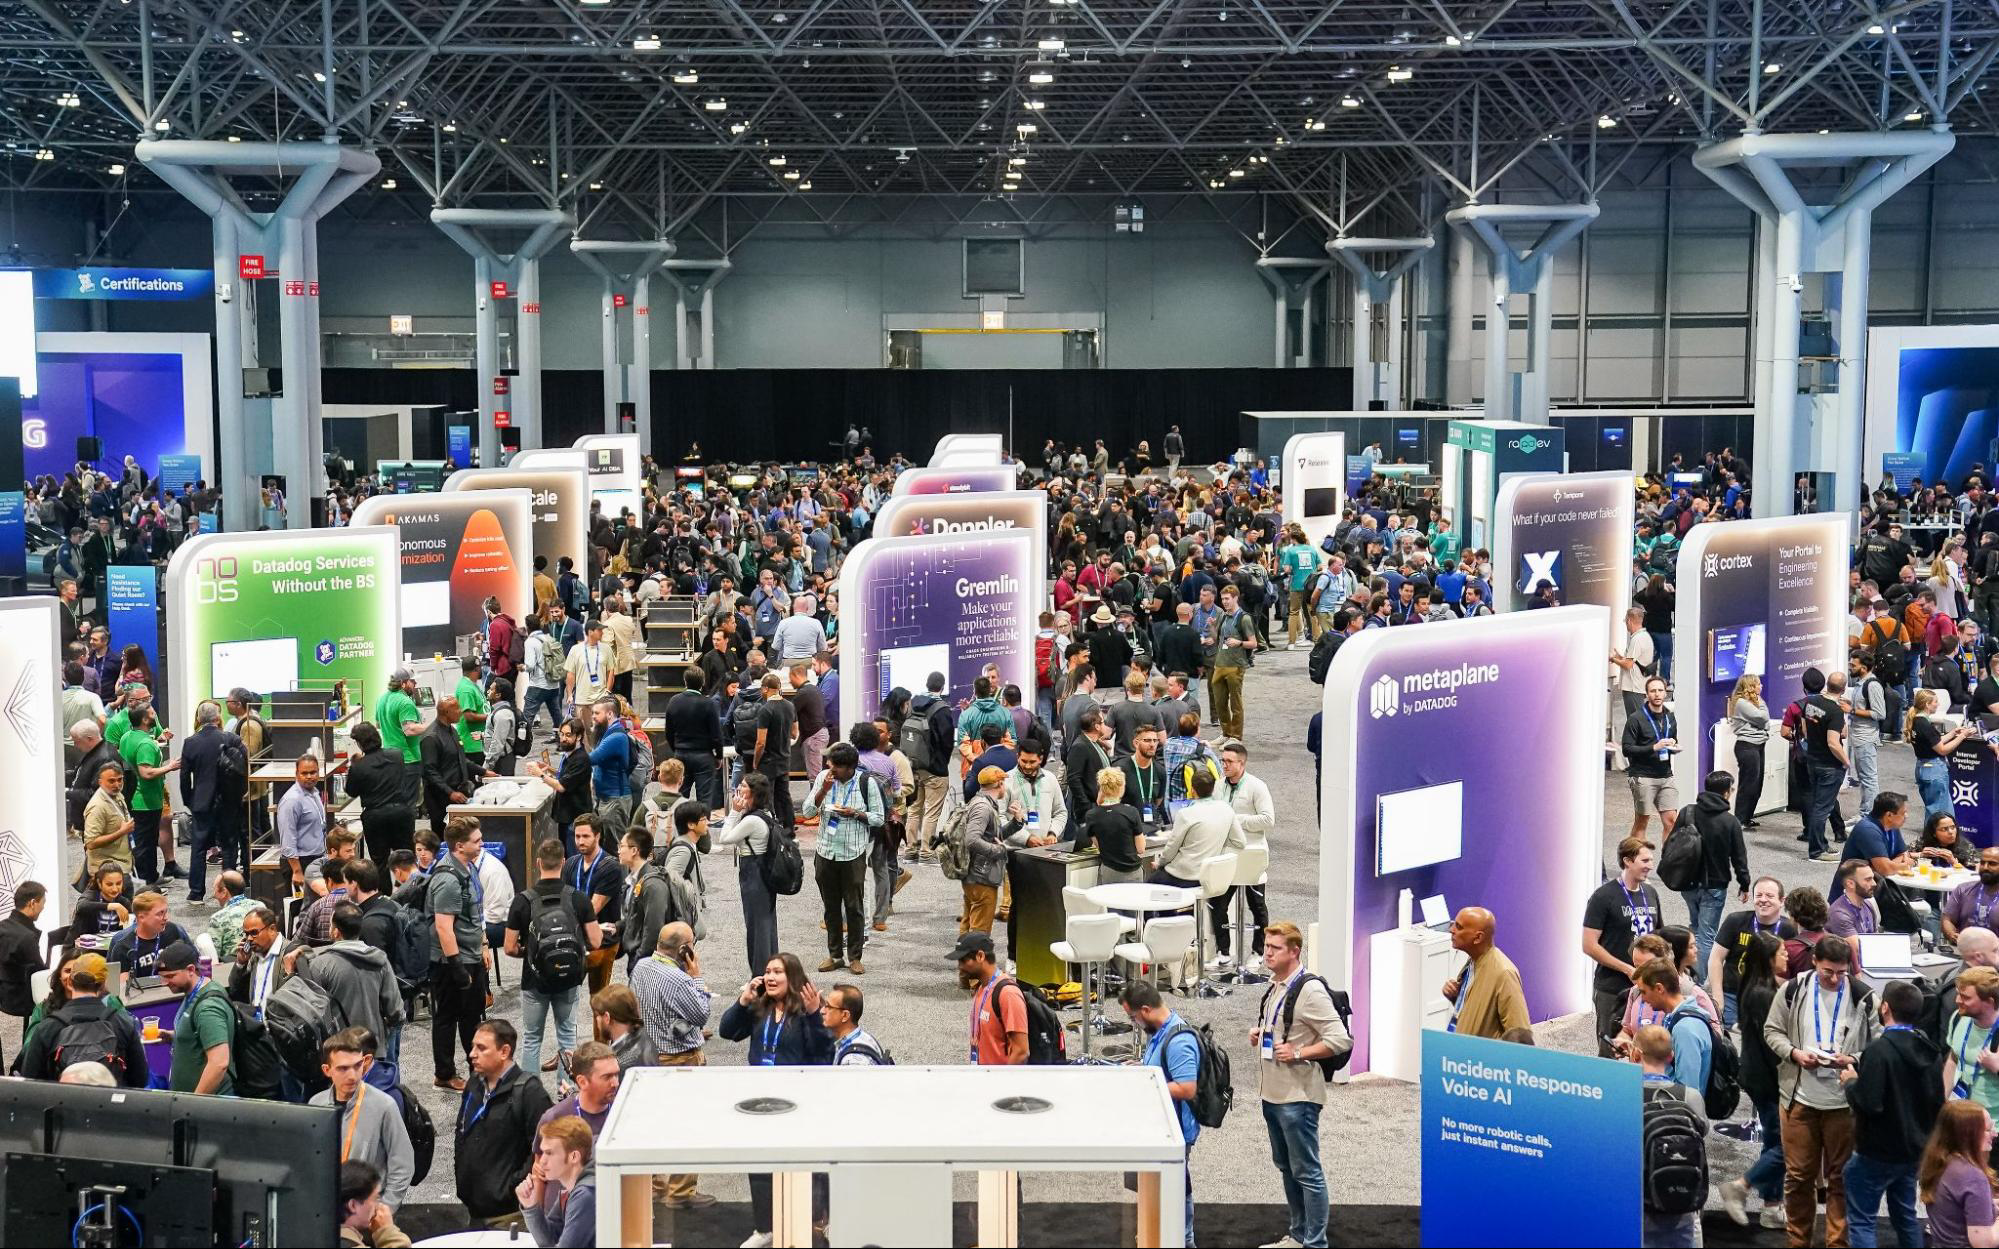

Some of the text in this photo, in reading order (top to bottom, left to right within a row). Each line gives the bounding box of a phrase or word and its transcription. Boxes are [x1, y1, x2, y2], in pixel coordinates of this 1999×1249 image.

[100, 277, 184, 292] Certifications
[532, 489, 557, 505] cale
[398, 514, 439, 524] AKAMAS
[1513, 513, 1533, 526] What
[1534, 512, 1539, 523] if
[1540, 513, 1556, 526] your
[1558, 511, 1576, 521] code
[1578, 511, 1598, 520] never
[400, 538, 446, 551] onomous
[1779, 544, 1822, 558] Your Portal to
[253, 555, 375, 575] Datadog Services
[401, 552, 444, 565] mization
[1720, 554, 1752, 570] cortex
[1779, 561, 1817, 575] Engineering
[272, 575, 375, 594] Without the BS
[956, 574, 1019, 598] Gremlin
[1779, 576, 1813, 589] Excellence
[961, 601, 1013, 616] Make your
[958, 614, 1017, 635] applications
[956, 628, 1019, 646] more reliable
[339, 642, 374, 650] DATADOG
[340, 650, 375, 659] PARTNER
[1403, 663, 1499, 693] metaplane
[1403, 696, 1457, 716] by DATADOG
[1953, 757, 1981, 765] Developer
[1956, 751, 1977, 759] Internal
[1958, 763, 1974, 771] Portal
[1441, 1055, 1603, 1100] Incident Response
[1442, 1077, 1512, 1106] Voice AI
[1441, 1117, 1552, 1149] No more robotic calls,
[1441, 1128, 1544, 1158] just instant answers
